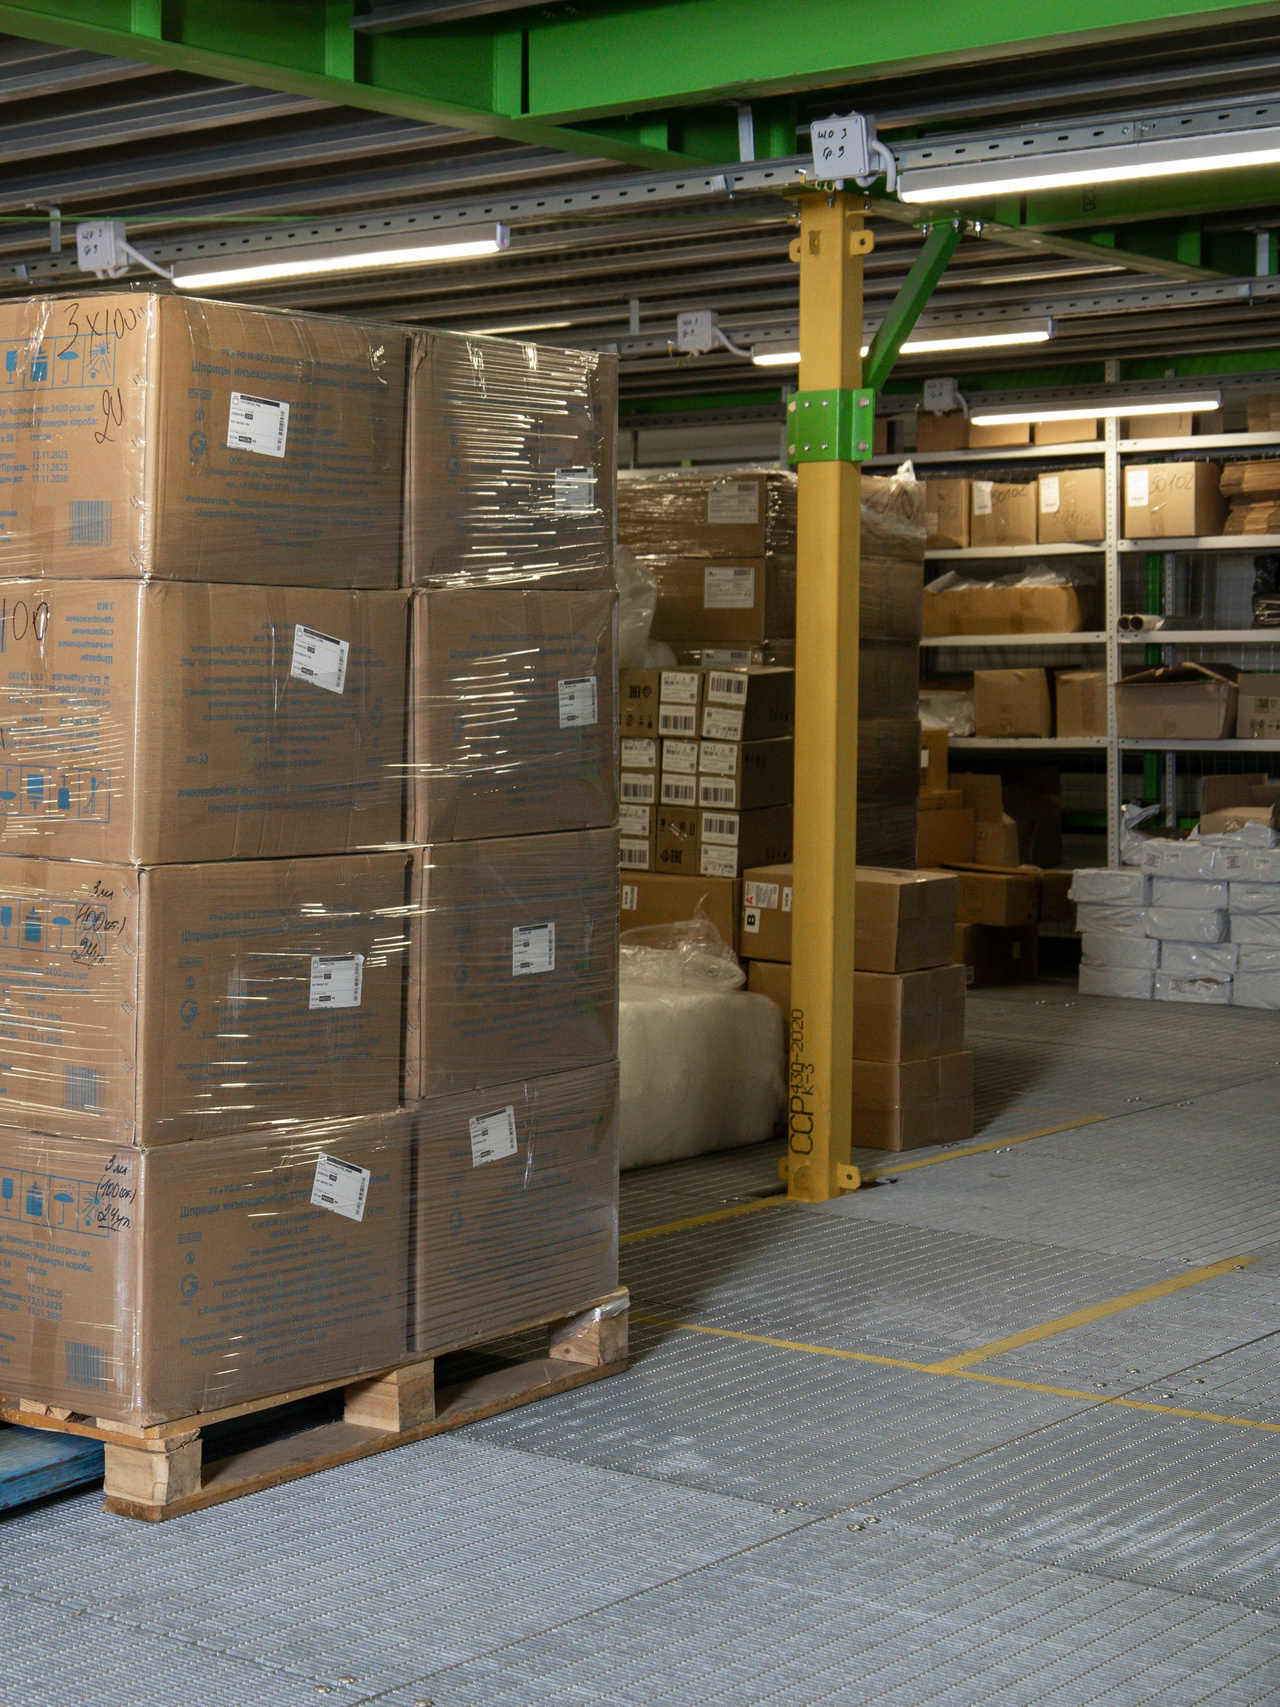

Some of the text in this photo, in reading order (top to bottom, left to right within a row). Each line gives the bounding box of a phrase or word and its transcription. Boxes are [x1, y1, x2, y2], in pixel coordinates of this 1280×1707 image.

[840, 128, 848, 139] 3
[838, 146, 844, 158] 9
[191, 360, 298, 384] Шприцы инъекционные
[51, 404, 68, 413] 2400
[37, 419, 68, 428] Размеры
[69, 418, 98, 426] короба:
[5, 434, 14, 442] 38
[32, 450, 69, 460] 12.11.2025
[32, 463, 68, 472] 12.11.2025
[32, 474, 68, 483] 11.11.2030
[96, 602, 114, 611] 3 МЛ
[65, 614, 114, 624] одноразовые
[72, 628, 114, 636] стерильные
[58, 640, 114, 650] инъекционные
[80, 654, 113, 664] Шприцы
[8, 672, 44, 680] 11.11.2030
[178, 786, 237, 798] одноразовые
[746, 914, 756, 926] B
[181, 930, 220, 943] Шприцы
[45, 968, 62, 978] 2400
[105, 1154, 116, 1171] 3
[180, 1192, 288, 1218] Шприцы инъекционные
[6, 1234, 46, 1250] Количество:
[47, 1243, 64, 1254] 2400
[65, 1246, 91, 1258] pcs./шт
[2, 1259, 11, 1268] 38
[34, 1253, 65, 1268] Размеры
[65, 1260, 94, 1272] короба:
[27, 1284, 63, 1298] 12.11.2025
[27, 1296, 63, 1311] 12.11.2025
[28, 1307, 63, 1322] 11.11.2030
